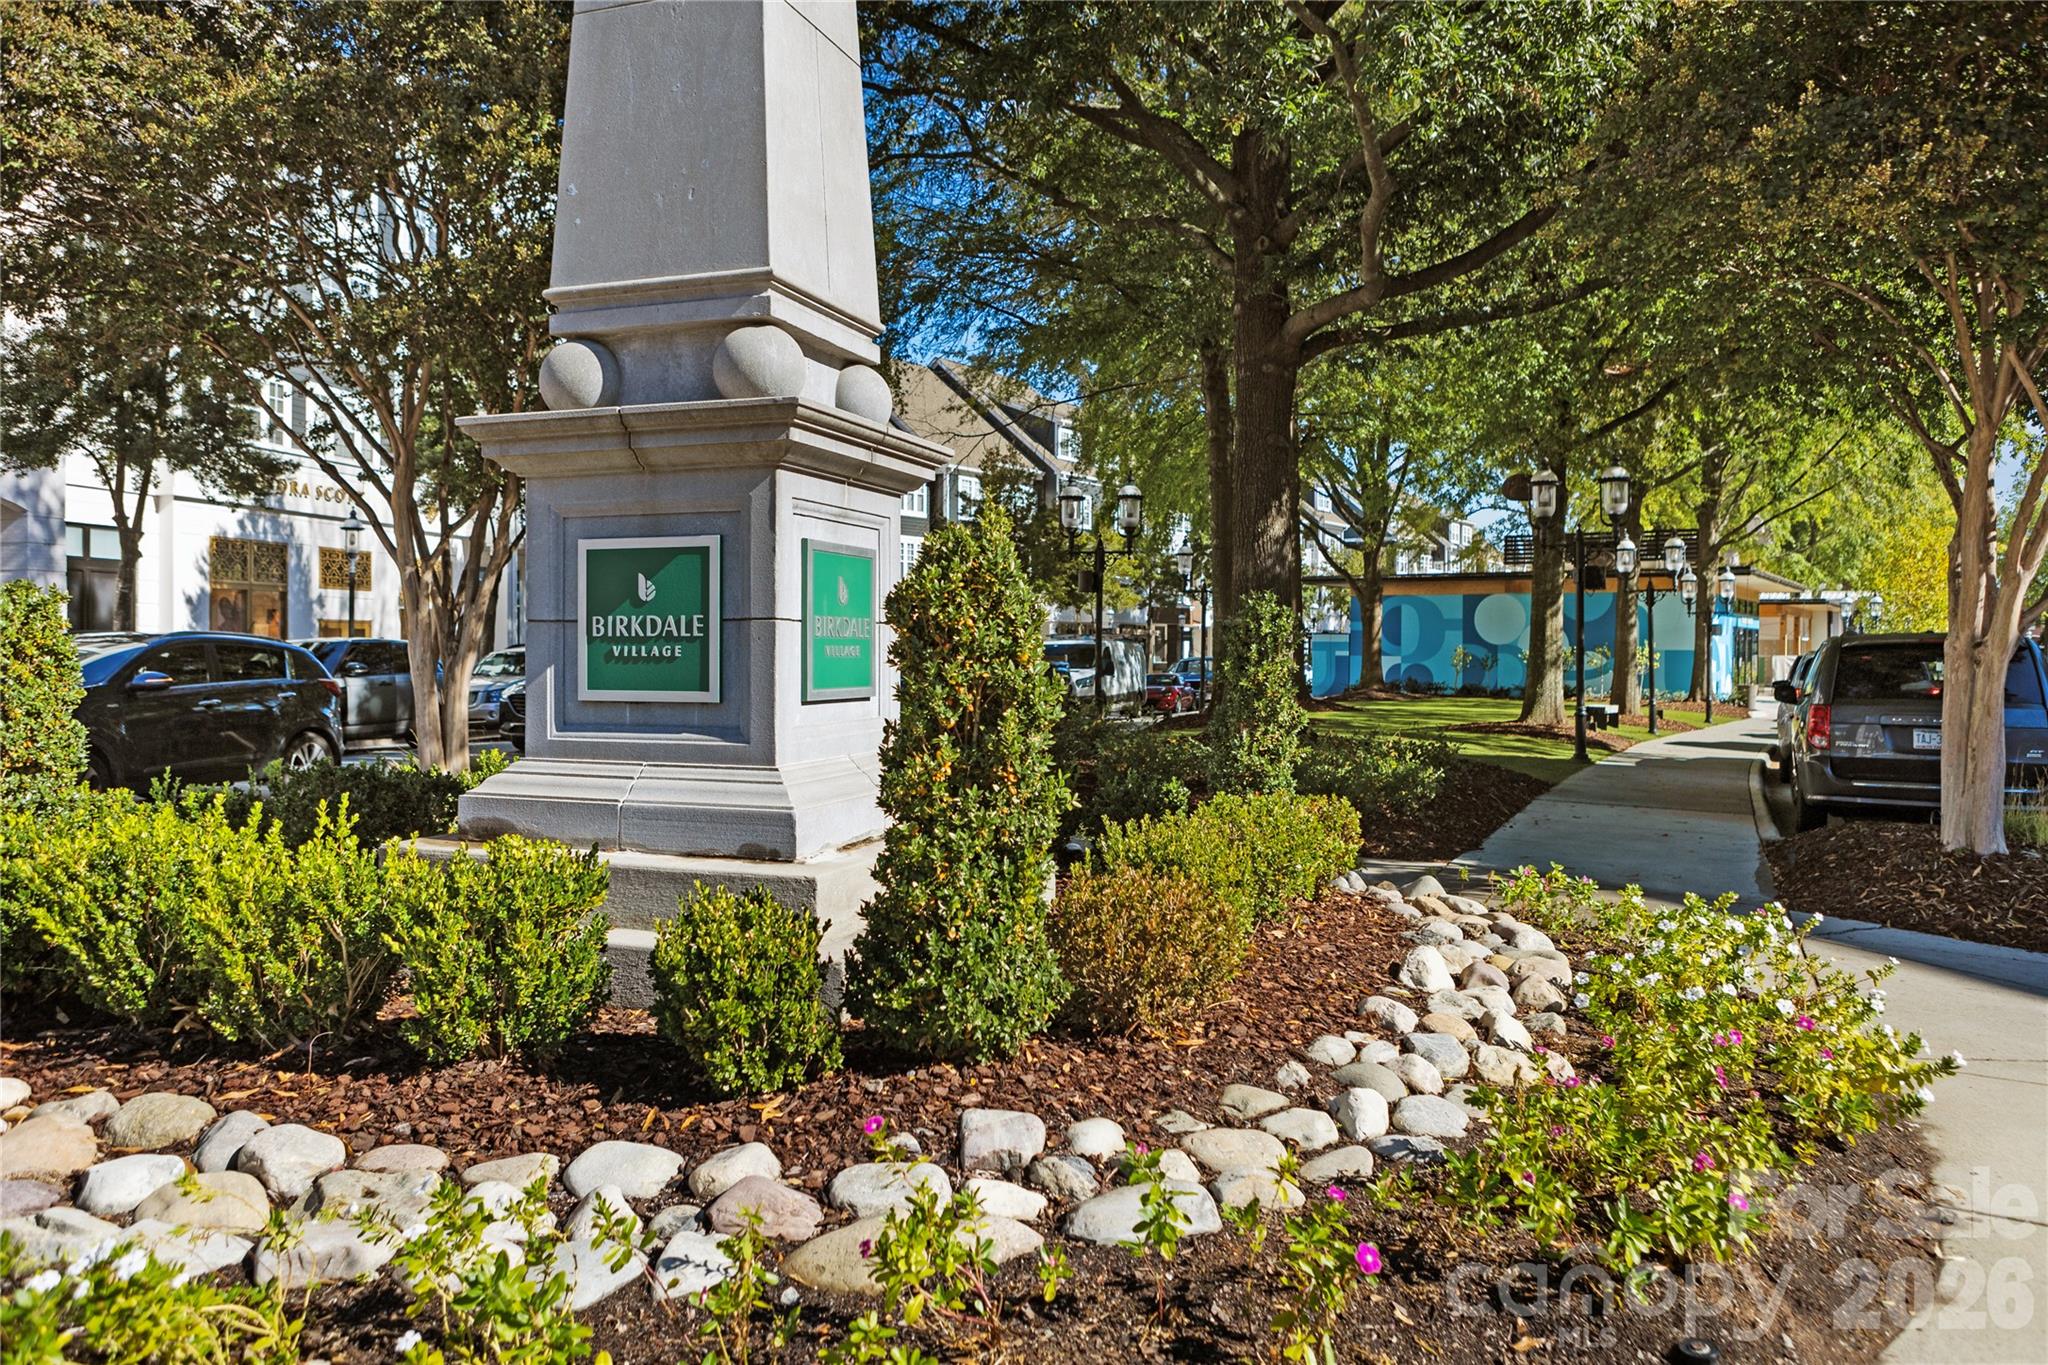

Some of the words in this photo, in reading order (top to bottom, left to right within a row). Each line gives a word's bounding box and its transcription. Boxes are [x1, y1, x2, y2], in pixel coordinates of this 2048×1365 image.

[591, 614, 704, 637] BIRKDALE
[815, 615, 871, 639] BIRKDALE
[611, 645, 682, 657] VILLAGE
[824, 644, 861, 657] VILLAGE
[1915, 733, 1943, 745] TAJ-3
